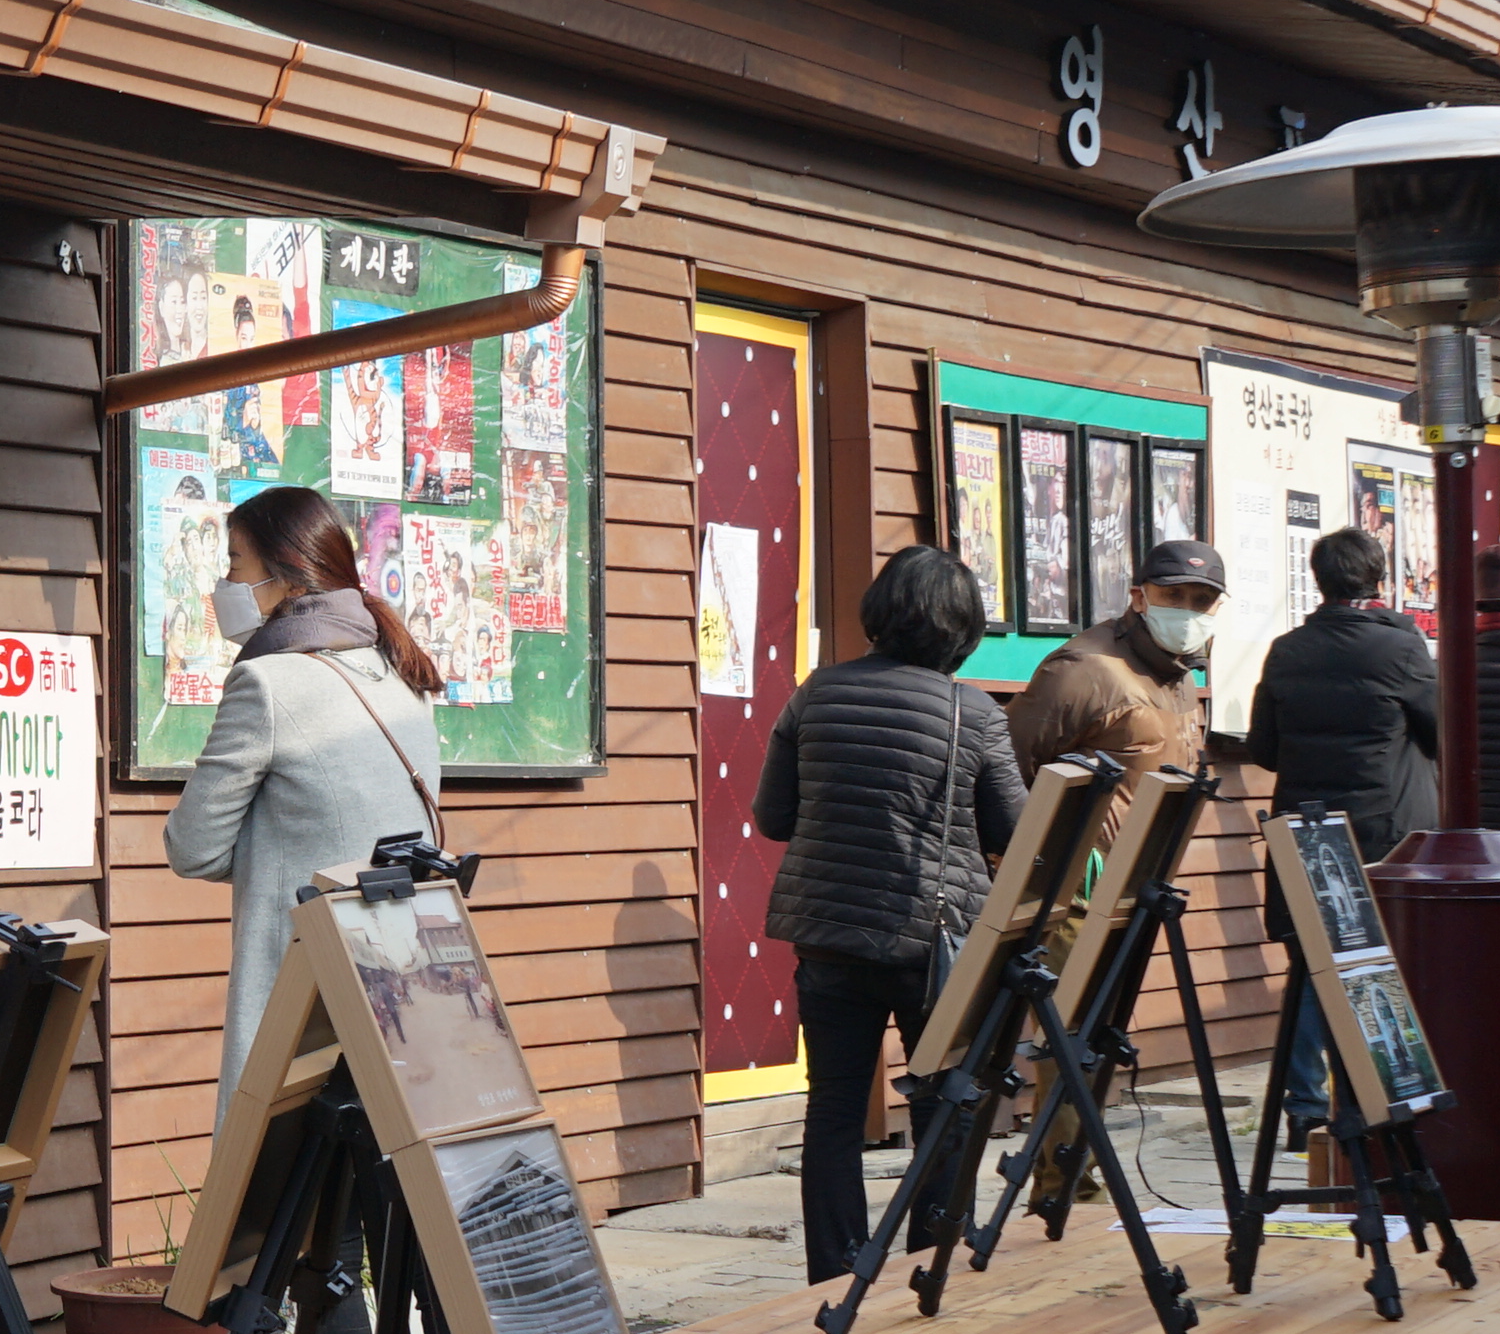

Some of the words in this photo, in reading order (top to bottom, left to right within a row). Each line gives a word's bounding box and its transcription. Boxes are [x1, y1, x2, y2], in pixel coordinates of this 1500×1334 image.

[340, 234, 414, 285] 게시판
[1242, 383, 1313, 440] 영산포극장
[39, 647, 77, 693] 商社
